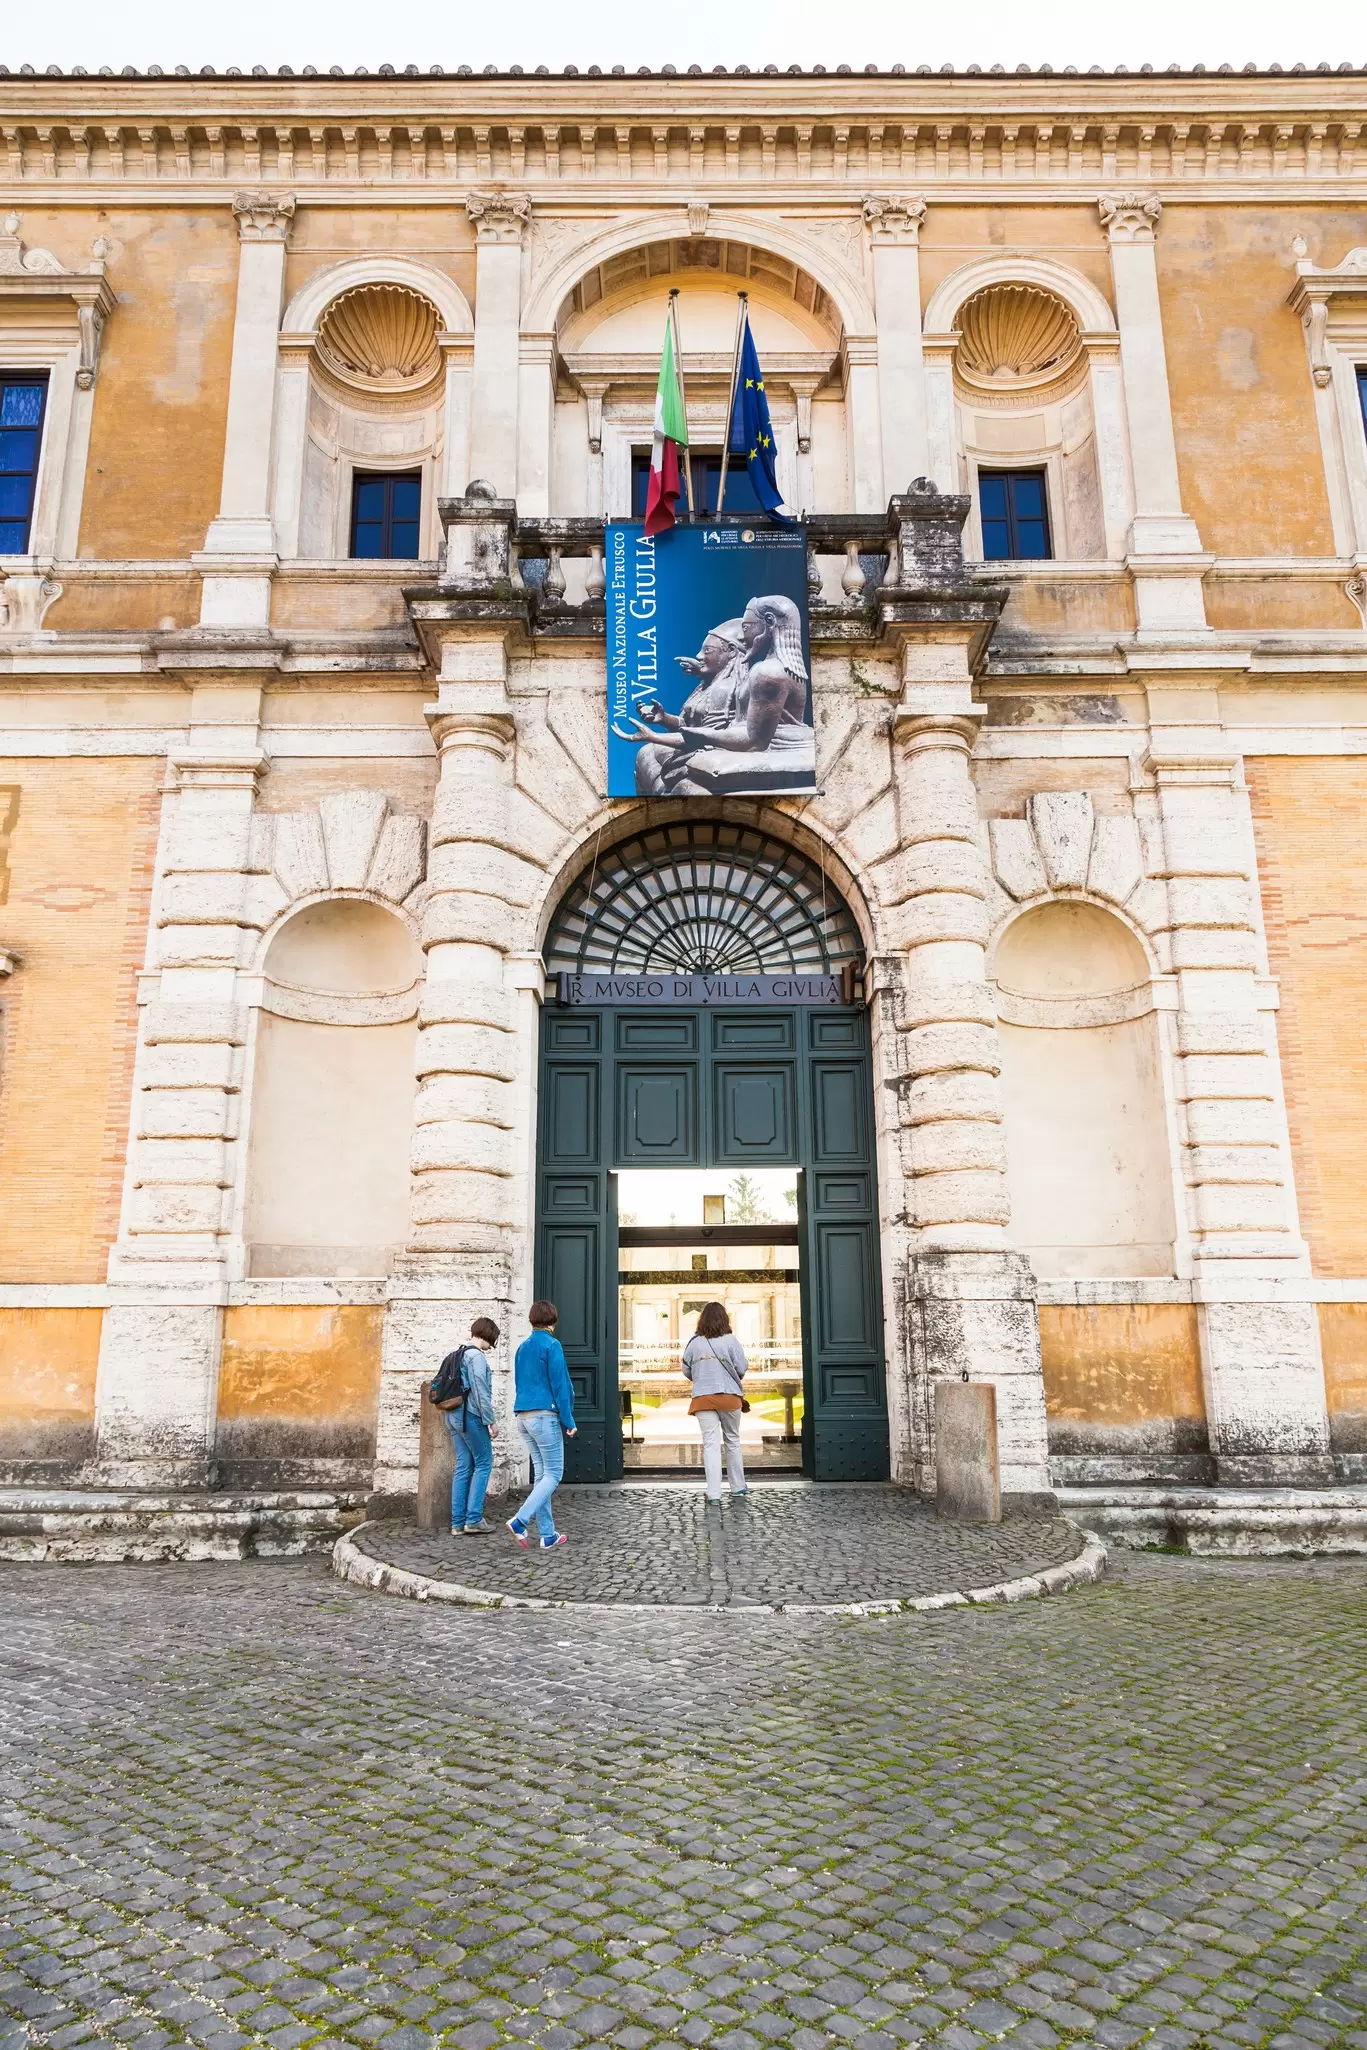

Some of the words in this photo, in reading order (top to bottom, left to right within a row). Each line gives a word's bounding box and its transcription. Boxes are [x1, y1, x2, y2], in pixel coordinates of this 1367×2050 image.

[611, 532, 626, 589] ETRUSCO
[629, 534, 657, 619] GIULIA
[612, 592, 627, 668] NAZIONALE
[631, 625, 658, 701] VILLA
[673, 981, 693, 997] DI
[703, 981, 762, 998] VILLA
